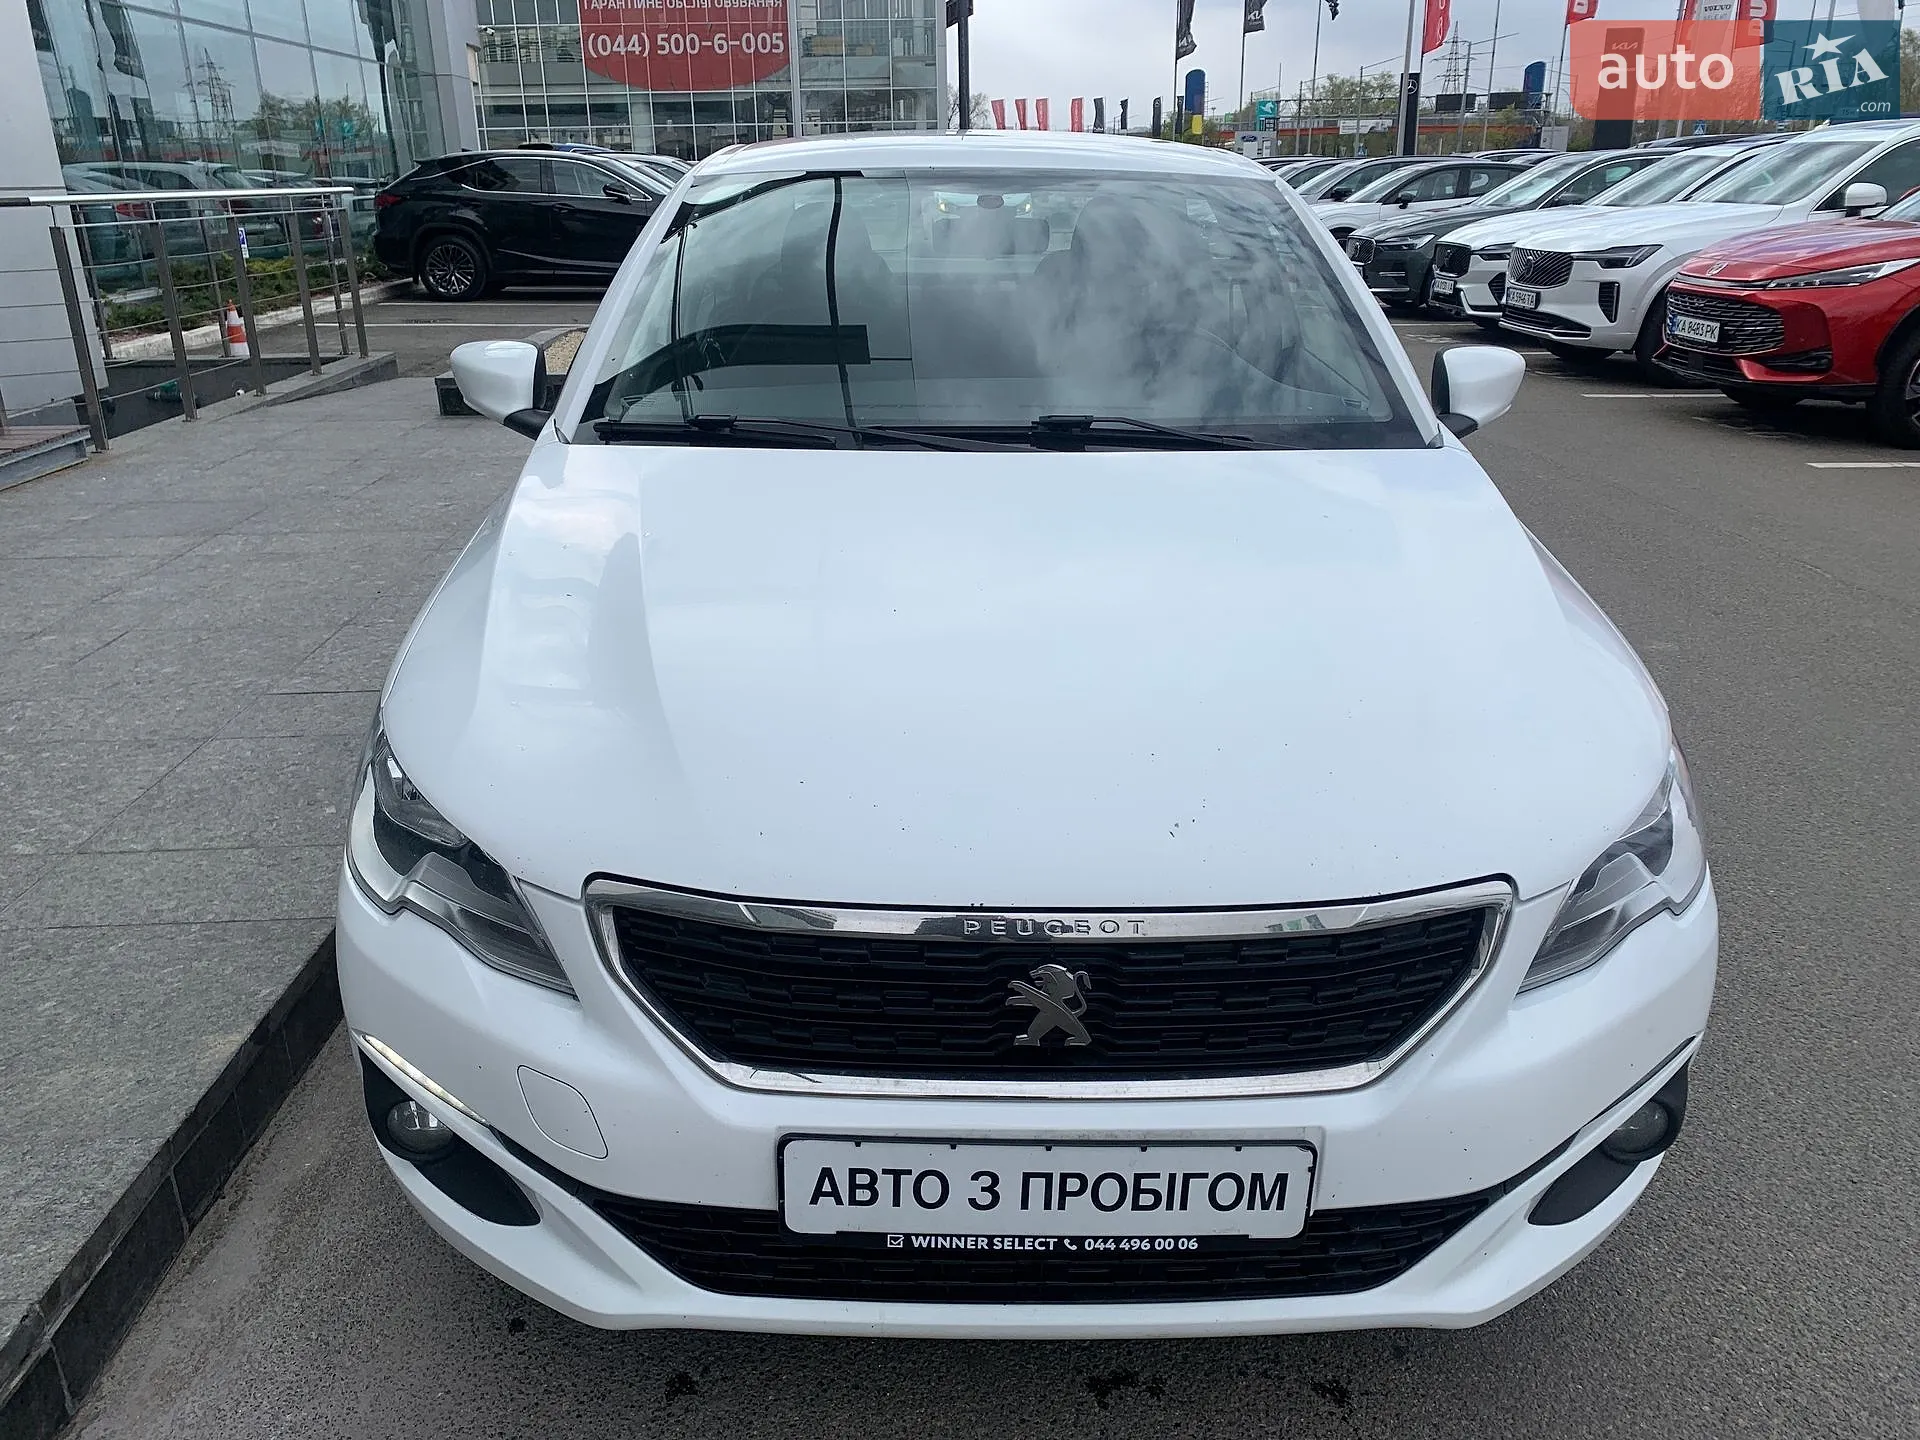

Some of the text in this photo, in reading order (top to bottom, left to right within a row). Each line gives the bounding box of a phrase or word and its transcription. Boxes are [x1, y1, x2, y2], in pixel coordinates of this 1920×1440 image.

[1704, 4, 1732, 12] VOLVO
[588, 32, 784, 58] (044) 500-6-005
[1687, 321, 1704, 336] 8483
[1705, 324, 1718, 339] PK
[963, 919, 1146, 936] PEUGEOT
[808, 1167, 950, 1210] АВТО
[1020, 1171, 1289, 1212] ПРОБІГОМ
[911, 1235, 1198, 1251] WINNER SELECT 044 496 00 06
